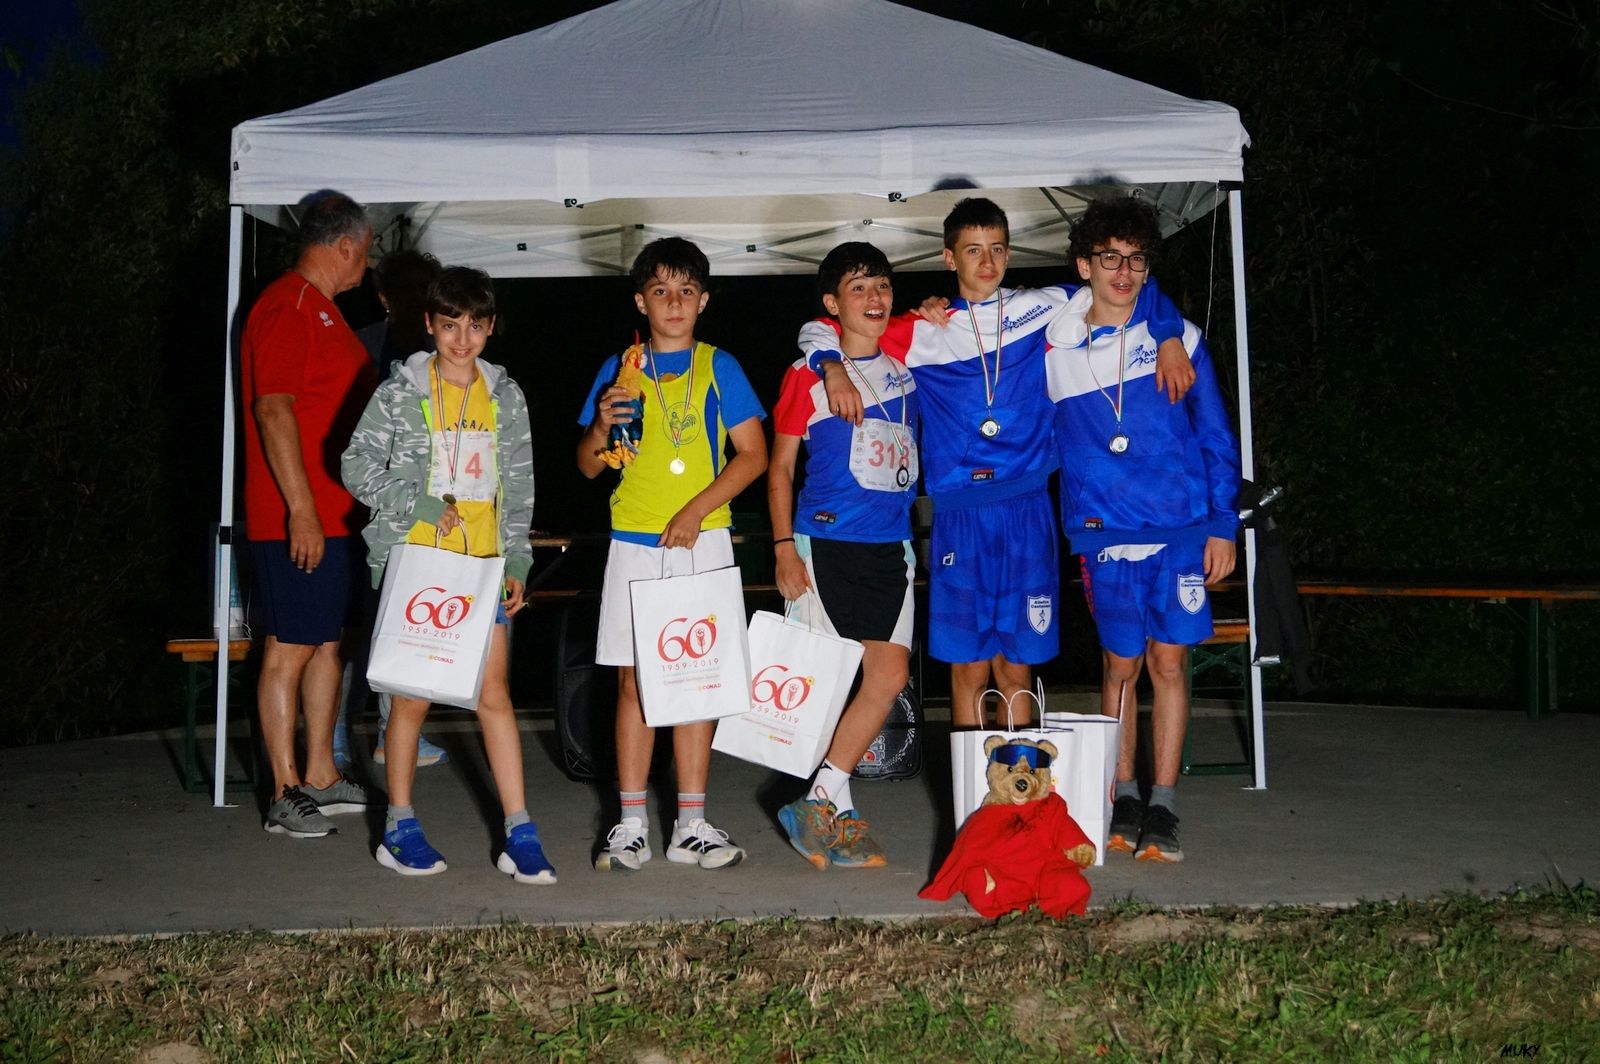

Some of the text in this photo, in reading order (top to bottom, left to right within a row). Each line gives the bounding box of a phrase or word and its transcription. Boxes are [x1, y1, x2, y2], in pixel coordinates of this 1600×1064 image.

[1012, 304, 1042, 326] Atletica
[1013, 304, 1053, 329] Castenaso
[464, 452, 483, 479] 4
[405, 586, 471, 629] 60
[402, 624, 461, 641] 1959-2019
[657, 617, 717, 662] 60
[434, 655, 454, 664] CONAD
[662, 657, 719, 672] 1959-2019
[751, 664, 811, 711] 60
[751, 702, 800, 724] 959-2019
[773, 736, 793, 746] CONAD
